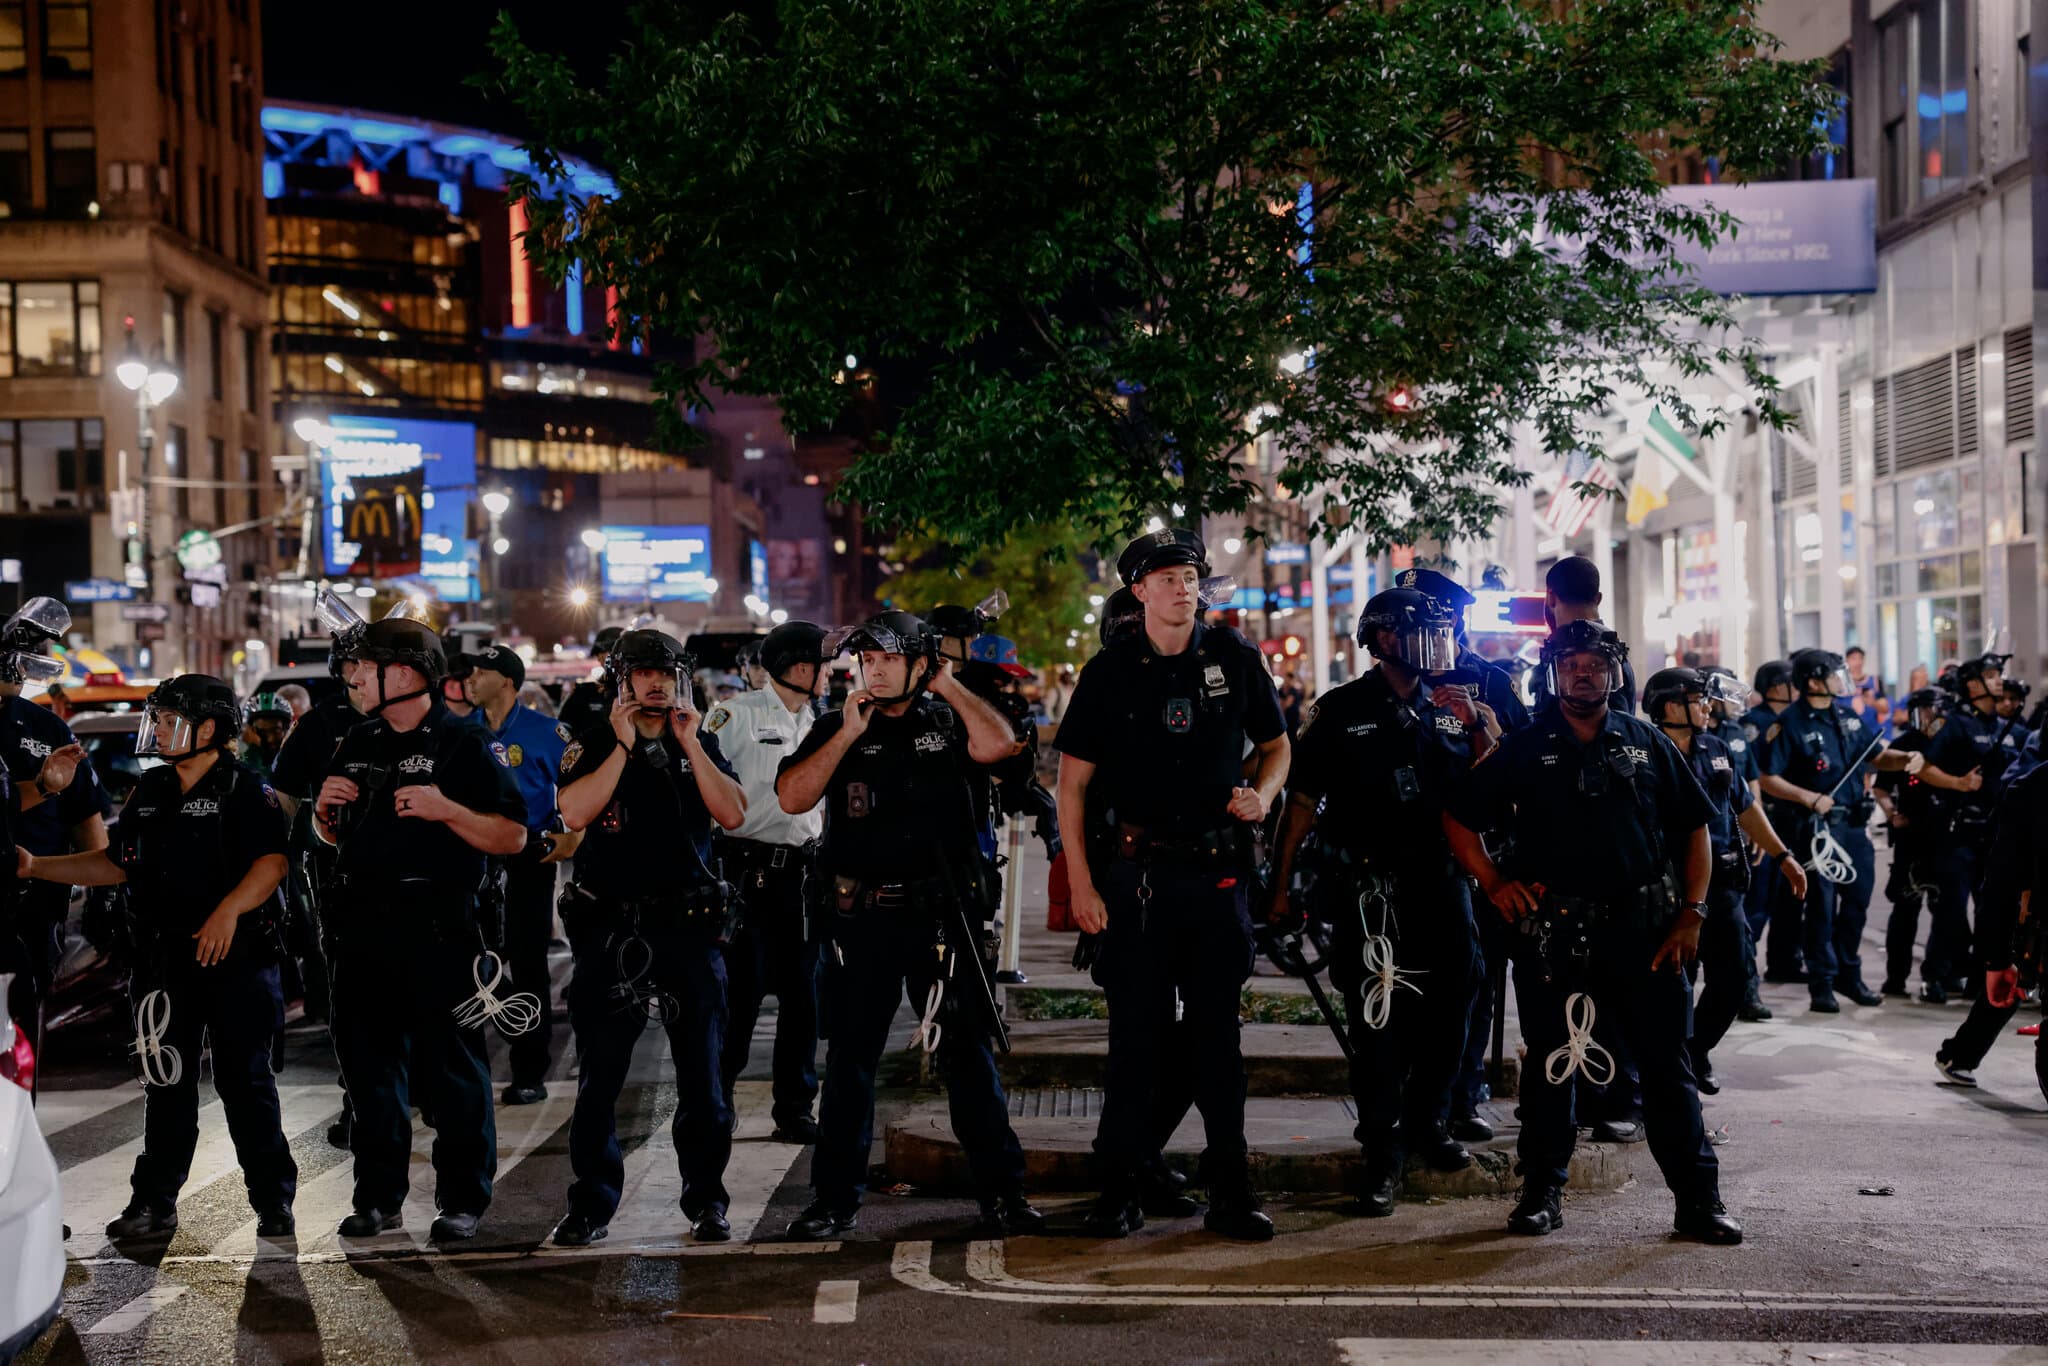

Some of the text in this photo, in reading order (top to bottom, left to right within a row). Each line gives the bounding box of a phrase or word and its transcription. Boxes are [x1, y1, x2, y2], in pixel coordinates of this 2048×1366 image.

[1435, 717, 1463, 728] POLIC
[20, 737, 53, 756] POLICE
[915, 735, 945, 747] POLIC
[398, 756, 435, 770] POLICE
[183, 801, 219, 810] POLICE
